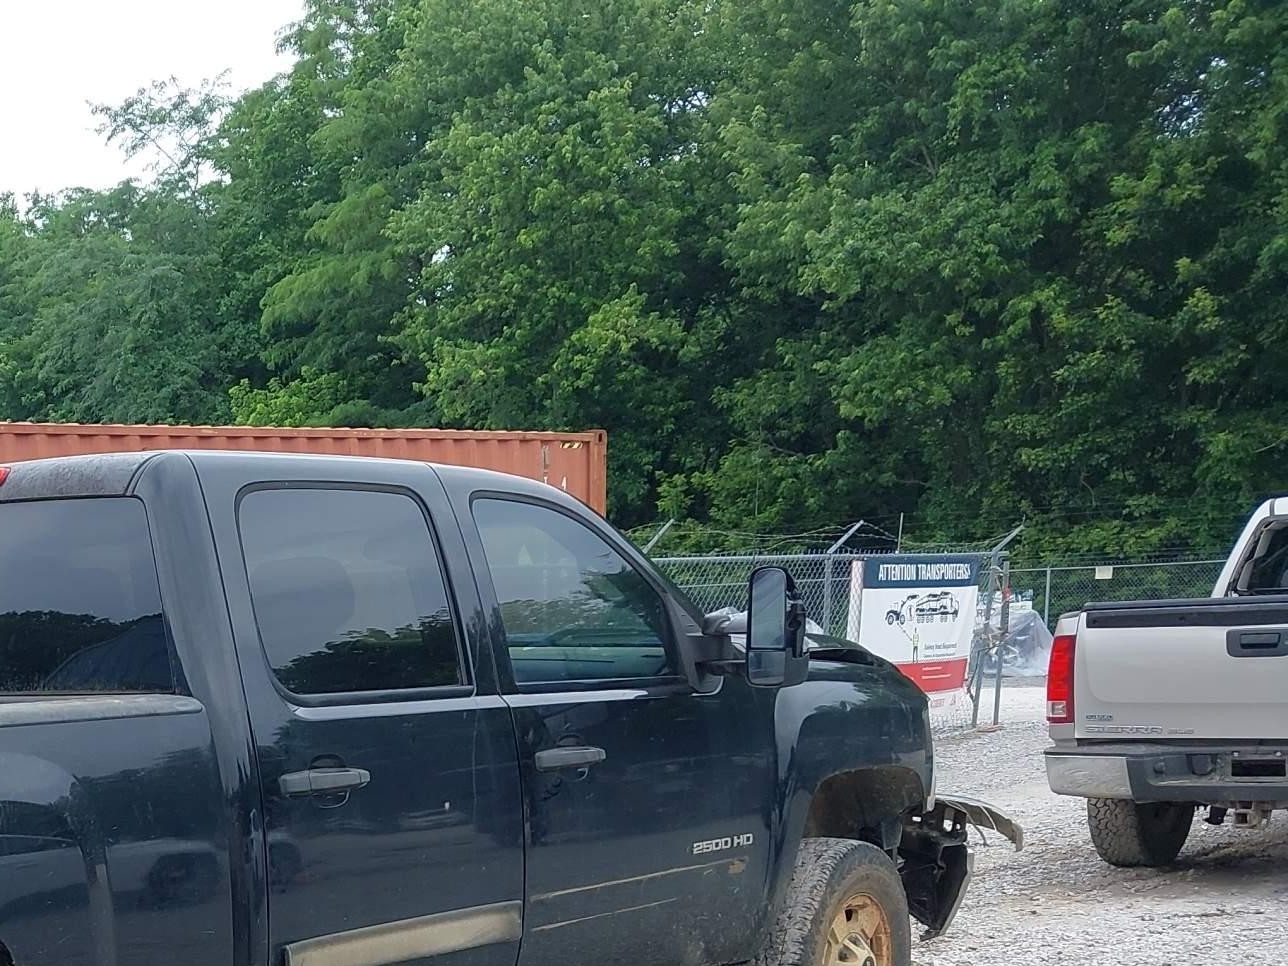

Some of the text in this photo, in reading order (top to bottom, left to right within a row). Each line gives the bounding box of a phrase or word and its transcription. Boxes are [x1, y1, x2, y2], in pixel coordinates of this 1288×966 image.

[878, 563, 915, 581] ATTENTION
[1085, 724, 1164, 735] SIERRA
[692, 833, 754, 855] 2500 HD
